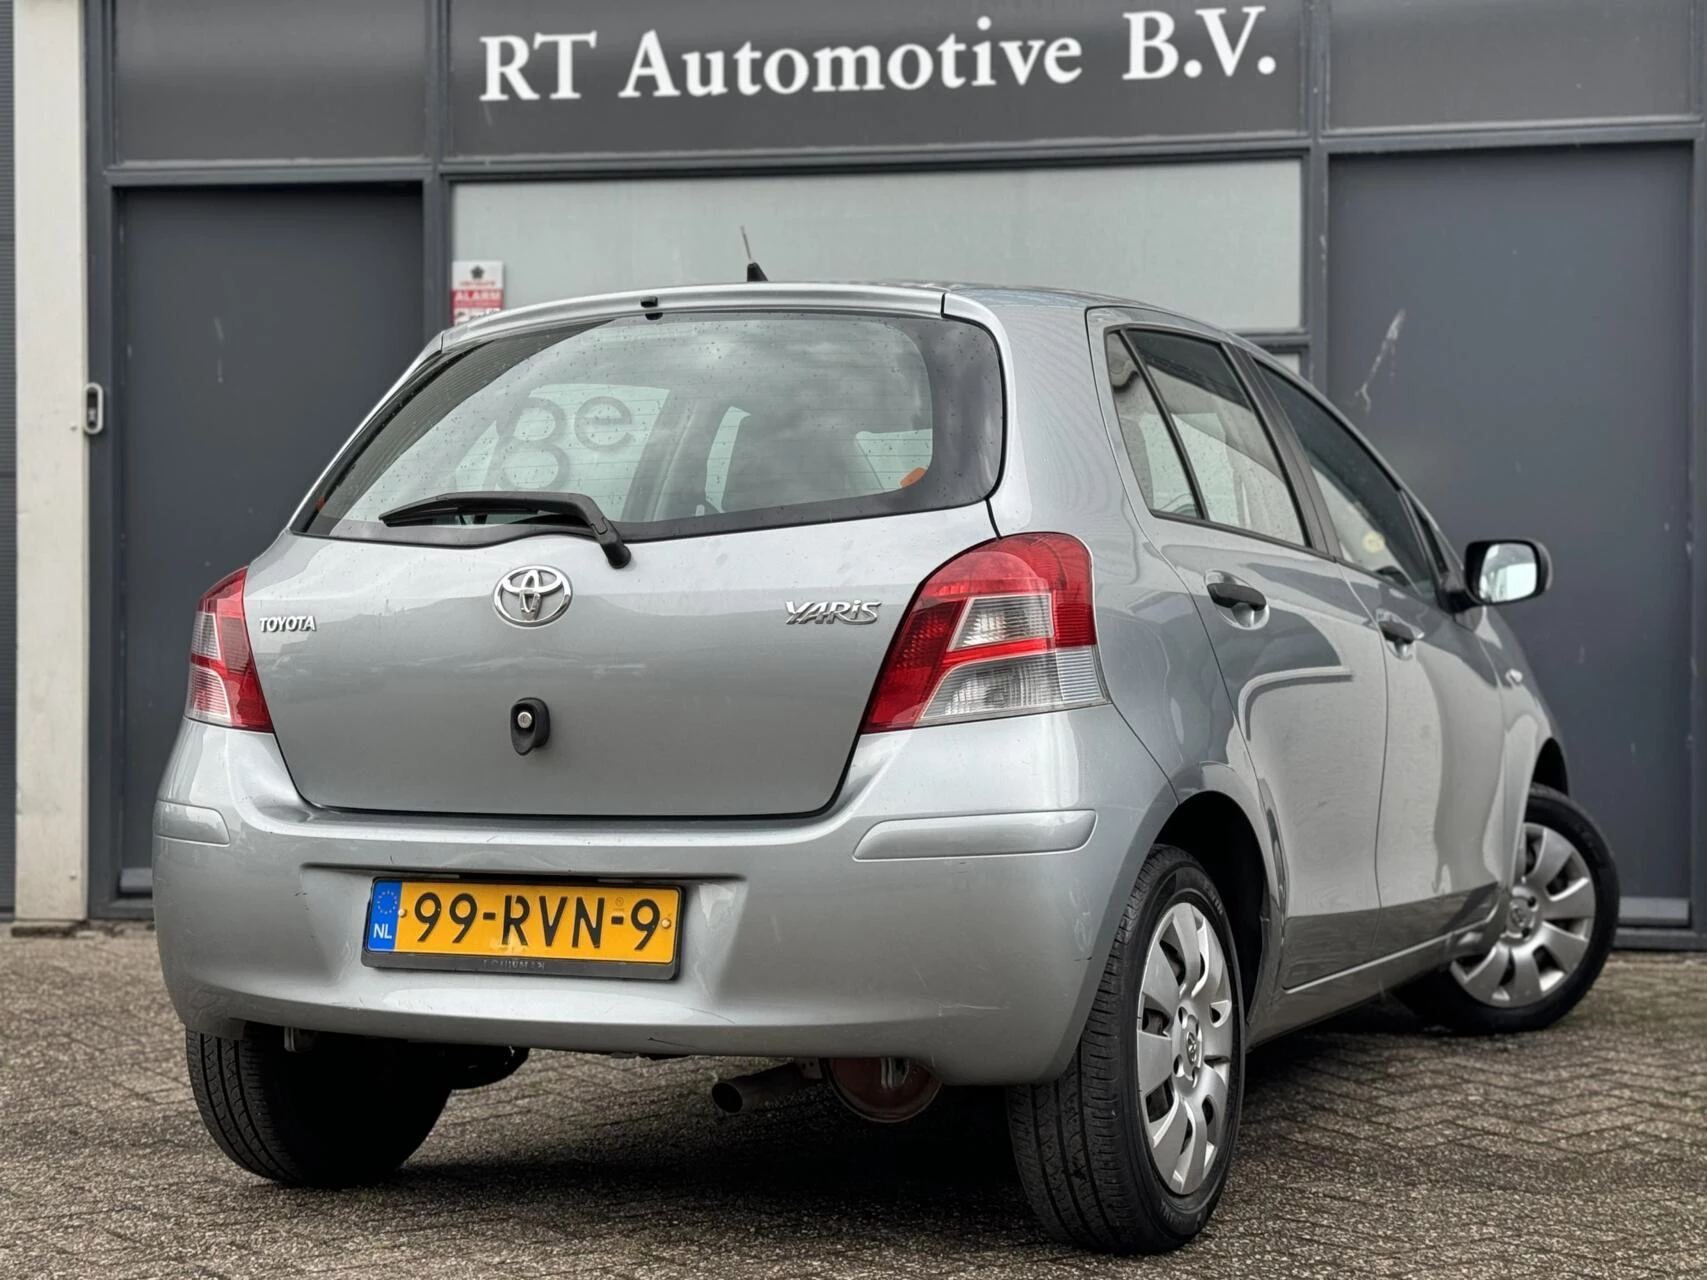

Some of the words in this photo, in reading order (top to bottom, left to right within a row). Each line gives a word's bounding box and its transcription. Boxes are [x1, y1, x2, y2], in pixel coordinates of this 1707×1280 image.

[480, 31, 598, 101] RT
[618, 15, 1082, 98] Automotive
[1122, 5, 1276, 80] B.V.
[454, 289, 502, 300] ALARM
[259, 615, 317, 632] TOYOTA
[414, 891, 661, 951] 99-RVN-9
[373, 922, 393, 940] NL
